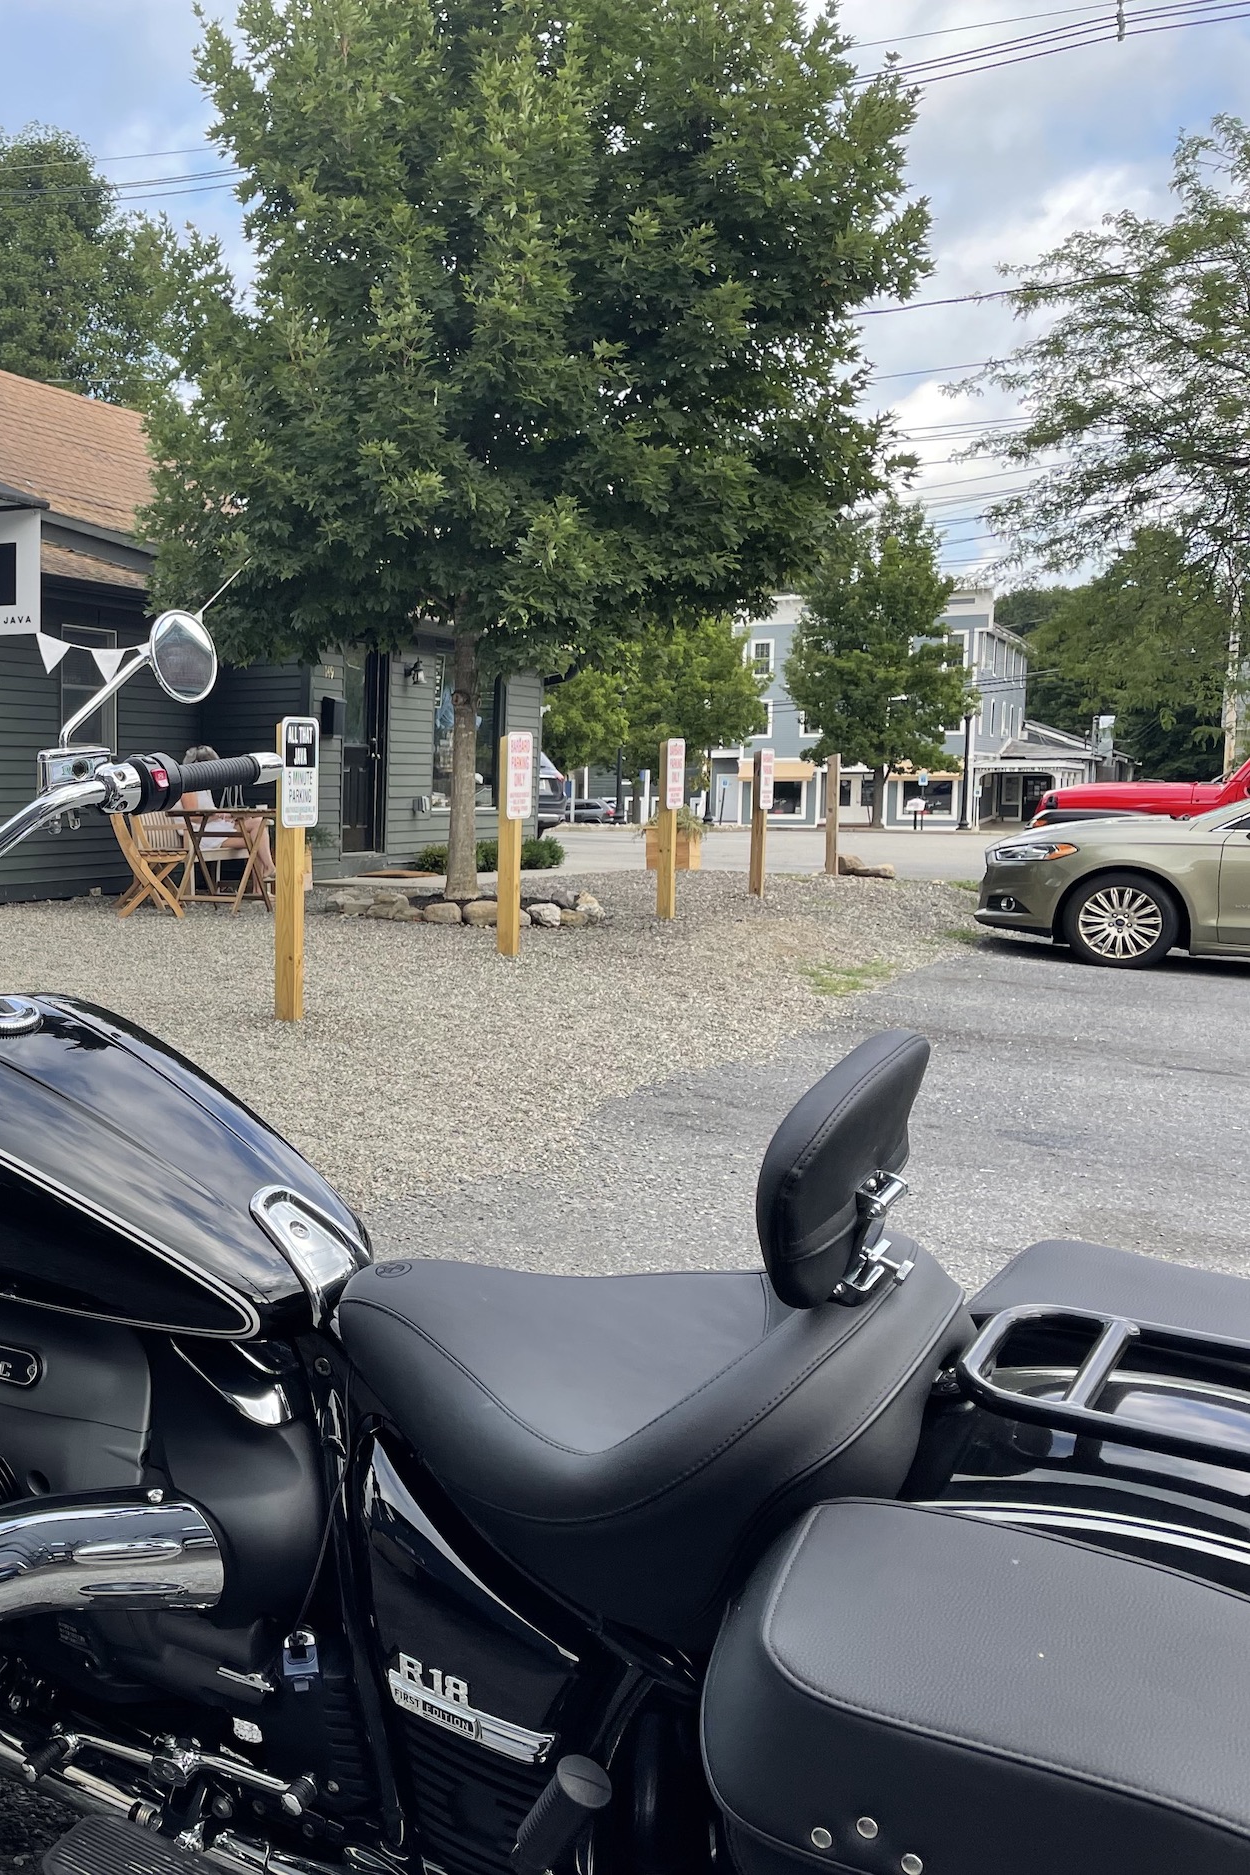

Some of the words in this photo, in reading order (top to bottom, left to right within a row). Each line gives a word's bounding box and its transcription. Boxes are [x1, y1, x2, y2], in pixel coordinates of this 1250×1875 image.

[3, 616, 32, 625] JAVA
[288, 726, 298, 744] ALL
[299, 726, 313, 744] THAT
[294, 747, 307, 765] JAVA
[288, 771, 292, 785] 5
[293, 771, 312, 785] MINUTE
[289, 789, 312, 803] PARKING
[394, 1688, 419, 1708] FIRST
[425, 1703, 469, 1731] EDITION
